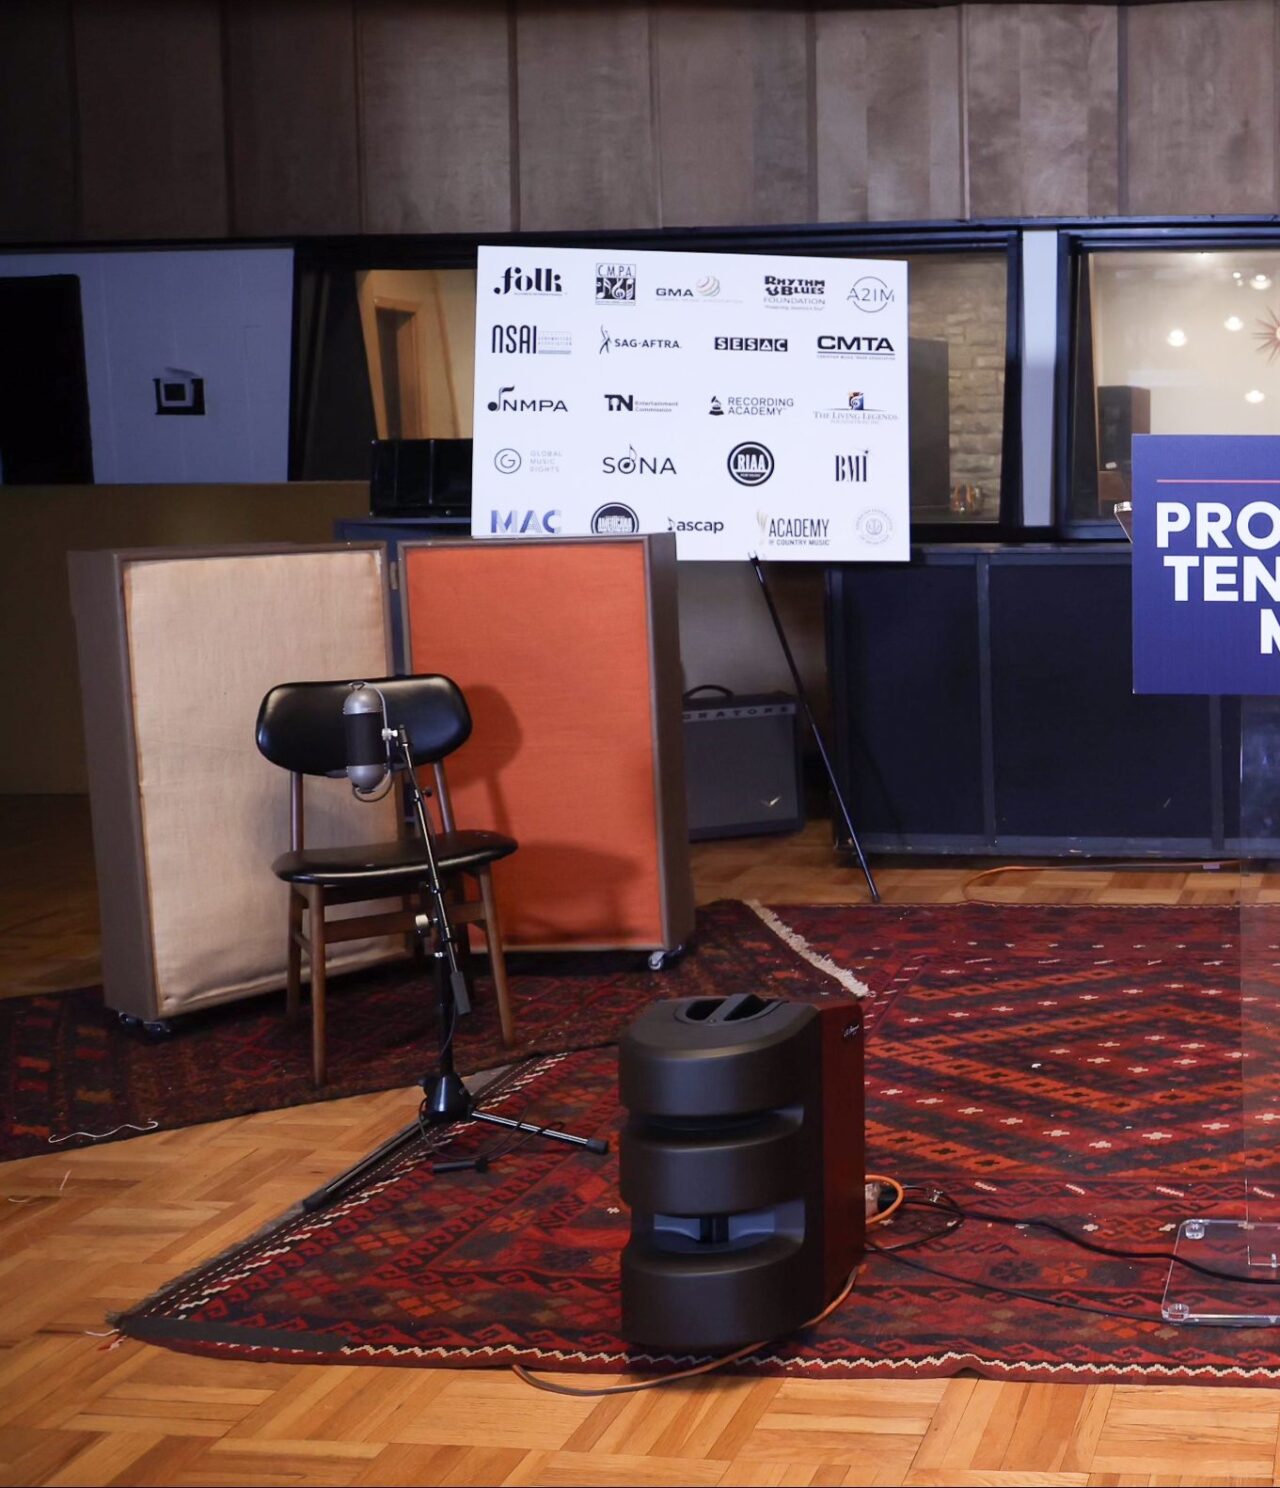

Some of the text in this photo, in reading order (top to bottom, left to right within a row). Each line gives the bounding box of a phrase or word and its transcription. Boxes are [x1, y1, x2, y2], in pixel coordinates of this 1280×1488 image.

[765, 275, 826, 287] RHYTHM
[655, 288, 694, 297] GMA
[780, 285, 825, 296] BLUES
[847, 287, 895, 303] A2IM
[764, 296, 826, 305] FOUNDATION
[492, 325, 537, 354] NSAI
[715, 337, 788, 352] SESAC
[817, 335, 894, 351] CMTA
[503, 400, 568, 412] NMPA
[604, 394, 633, 411] TN
[728, 397, 794, 407] RECORDING
[728, 406, 783, 416] ACADEMY
[602, 457, 677, 475] SONA
[737, 453, 768, 471] RIAA
[835, 455, 867, 482] BMI
[490, 509, 562, 534] MAC
[676, 520, 724, 534] ascap
[768, 518, 829, 538] ACADEMY
